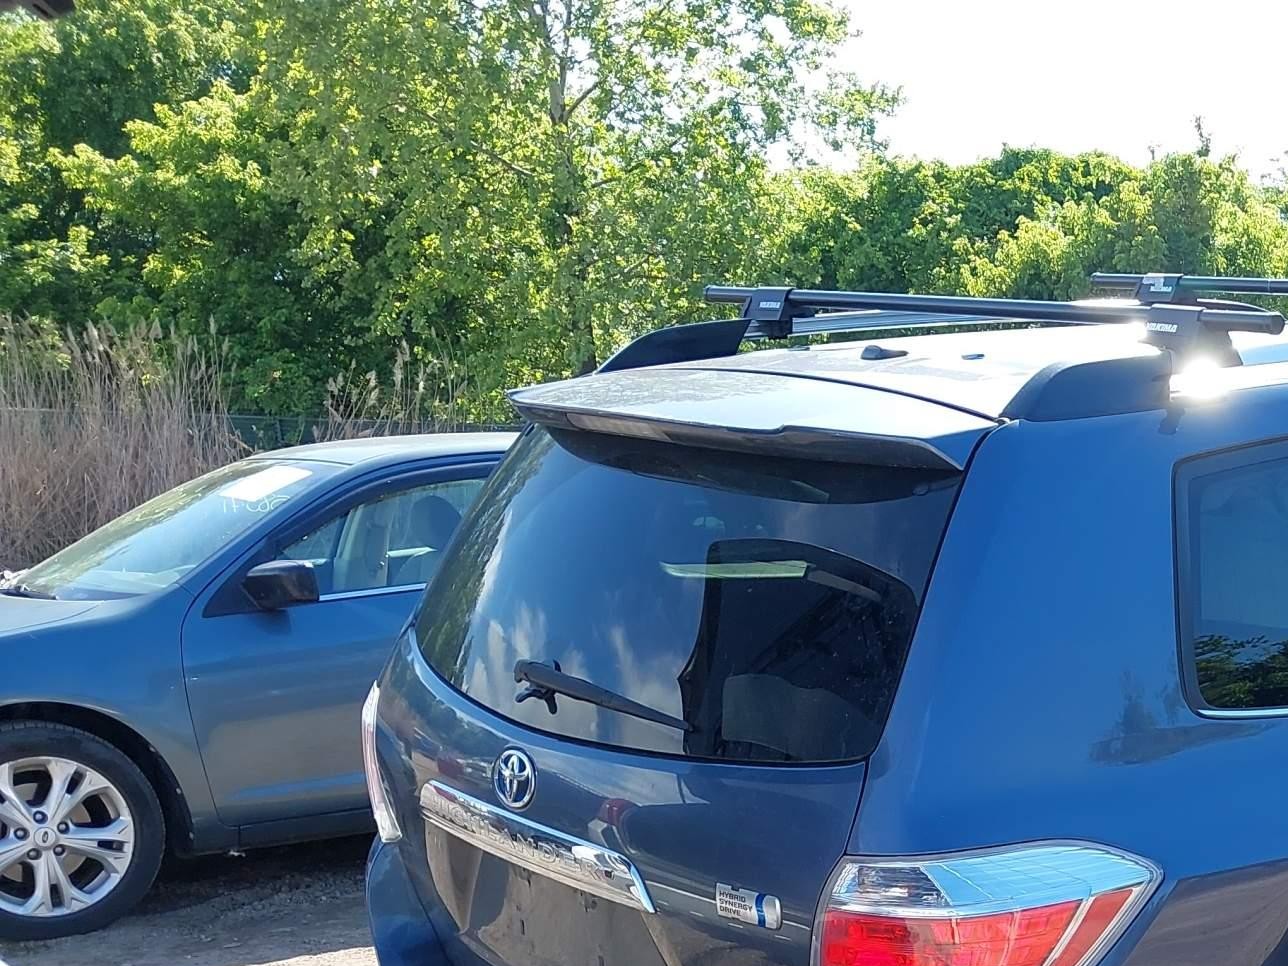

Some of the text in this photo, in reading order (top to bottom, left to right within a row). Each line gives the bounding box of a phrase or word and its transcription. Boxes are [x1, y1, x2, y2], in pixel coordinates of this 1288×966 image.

[430, 794, 602, 881] HIGHLANDER
[719, 890, 746, 903] HYBRID
[719, 898, 753, 912] SYNERGY
[719, 906, 742, 917] DRIVE
